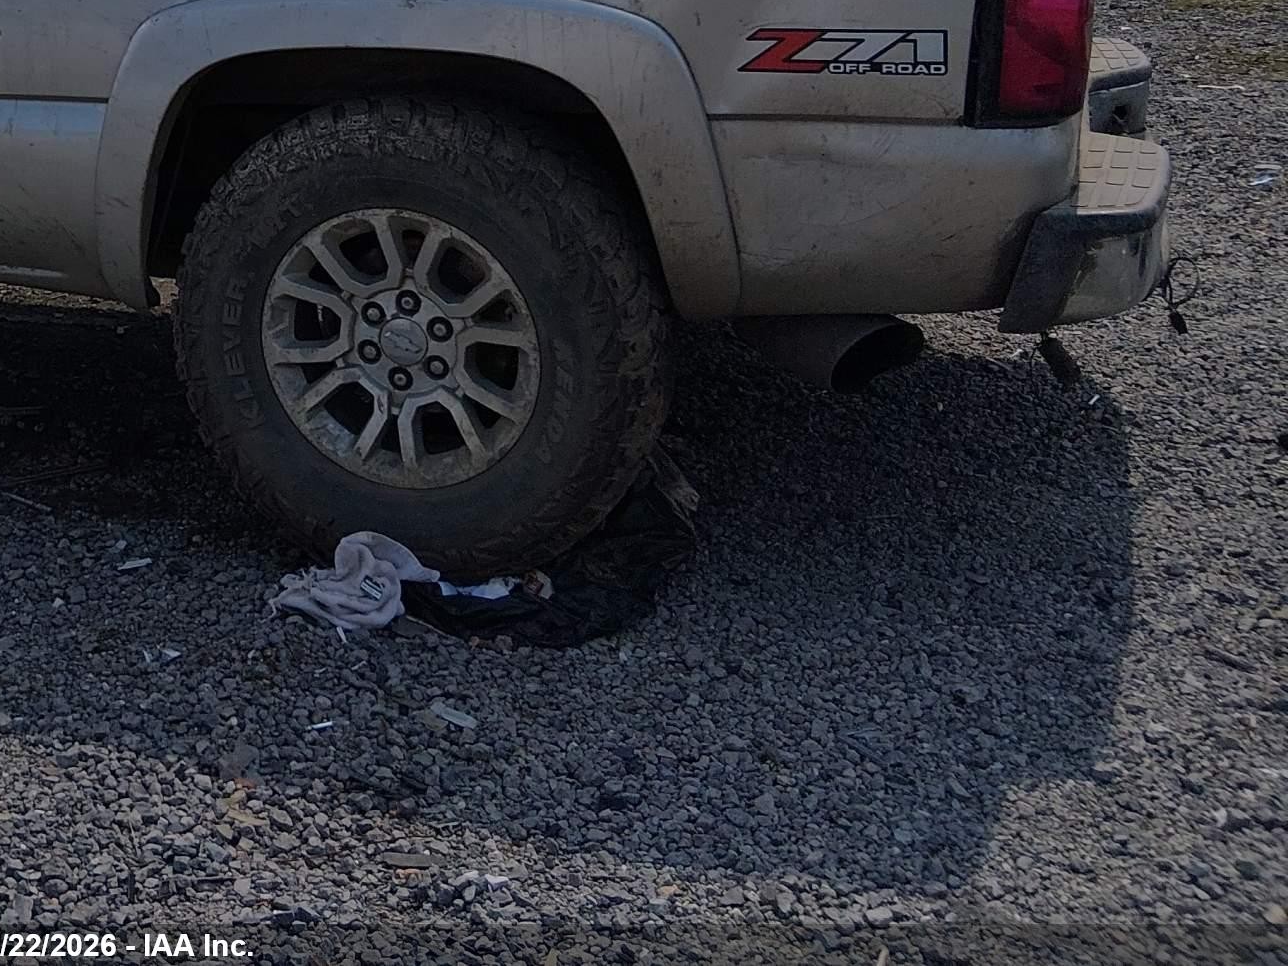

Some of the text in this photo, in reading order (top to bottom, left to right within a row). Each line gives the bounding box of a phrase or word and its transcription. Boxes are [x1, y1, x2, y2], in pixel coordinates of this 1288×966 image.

[737, 28, 948, 73] Z71
[828, 63, 946, 74] OFF ROAD
